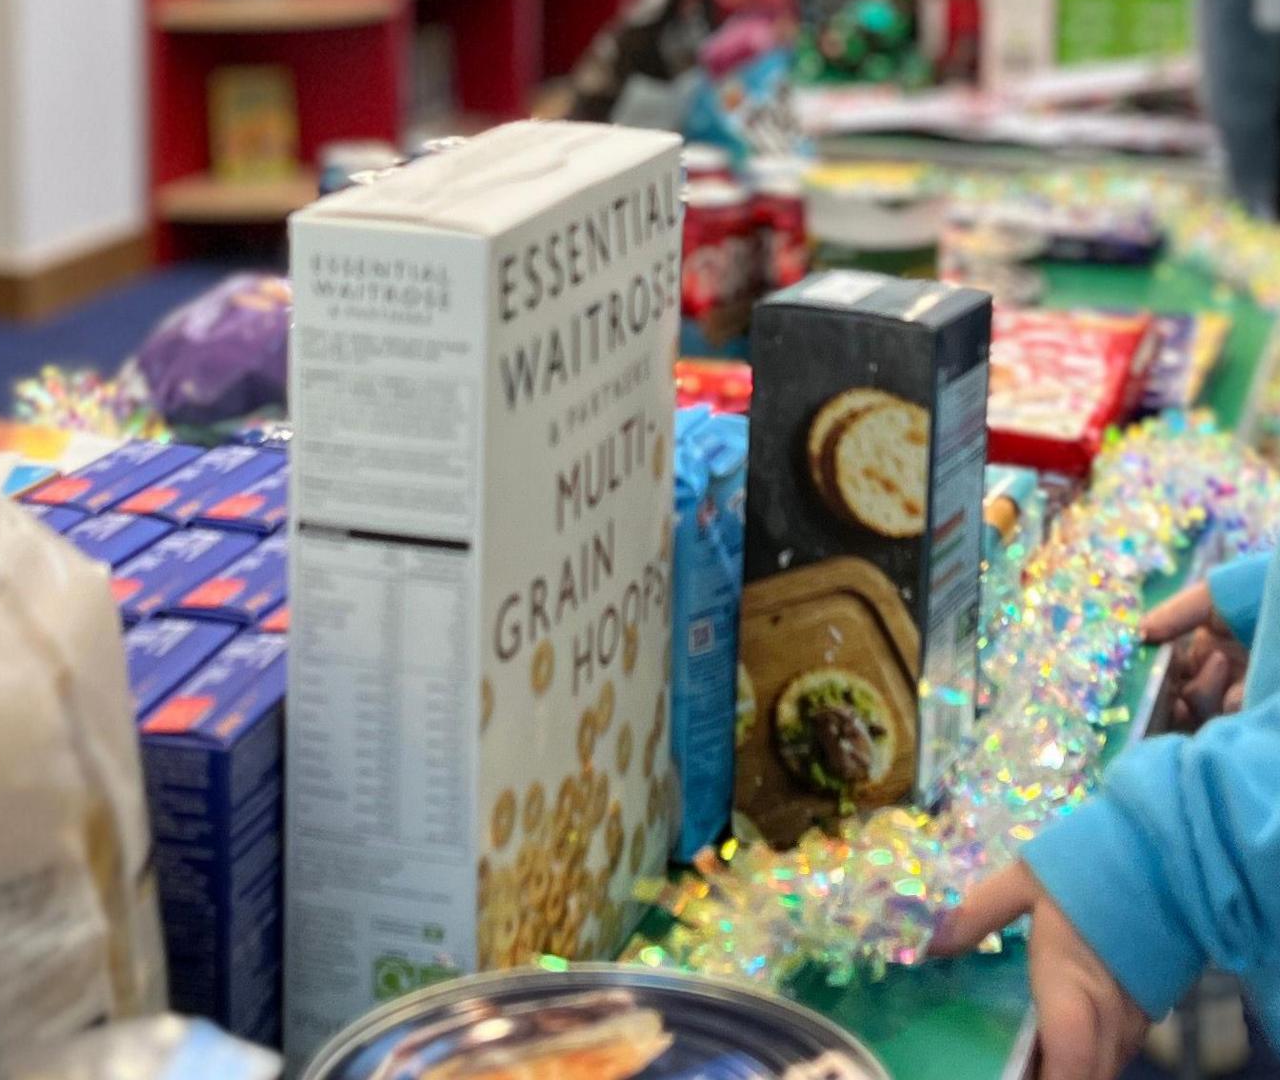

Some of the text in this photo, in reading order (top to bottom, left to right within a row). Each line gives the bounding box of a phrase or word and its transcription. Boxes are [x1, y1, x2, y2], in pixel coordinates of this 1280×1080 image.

[308, 250, 451, 284] ESSENTIAL
[308, 281, 452, 312] WAITROSE
[496, 172, 677, 322] ESSENTIAL
[498, 248, 677, 412] WAITROSE
[556, 410, 658, 533] MULTI-
[493, 518, 617, 663] GRAIN
